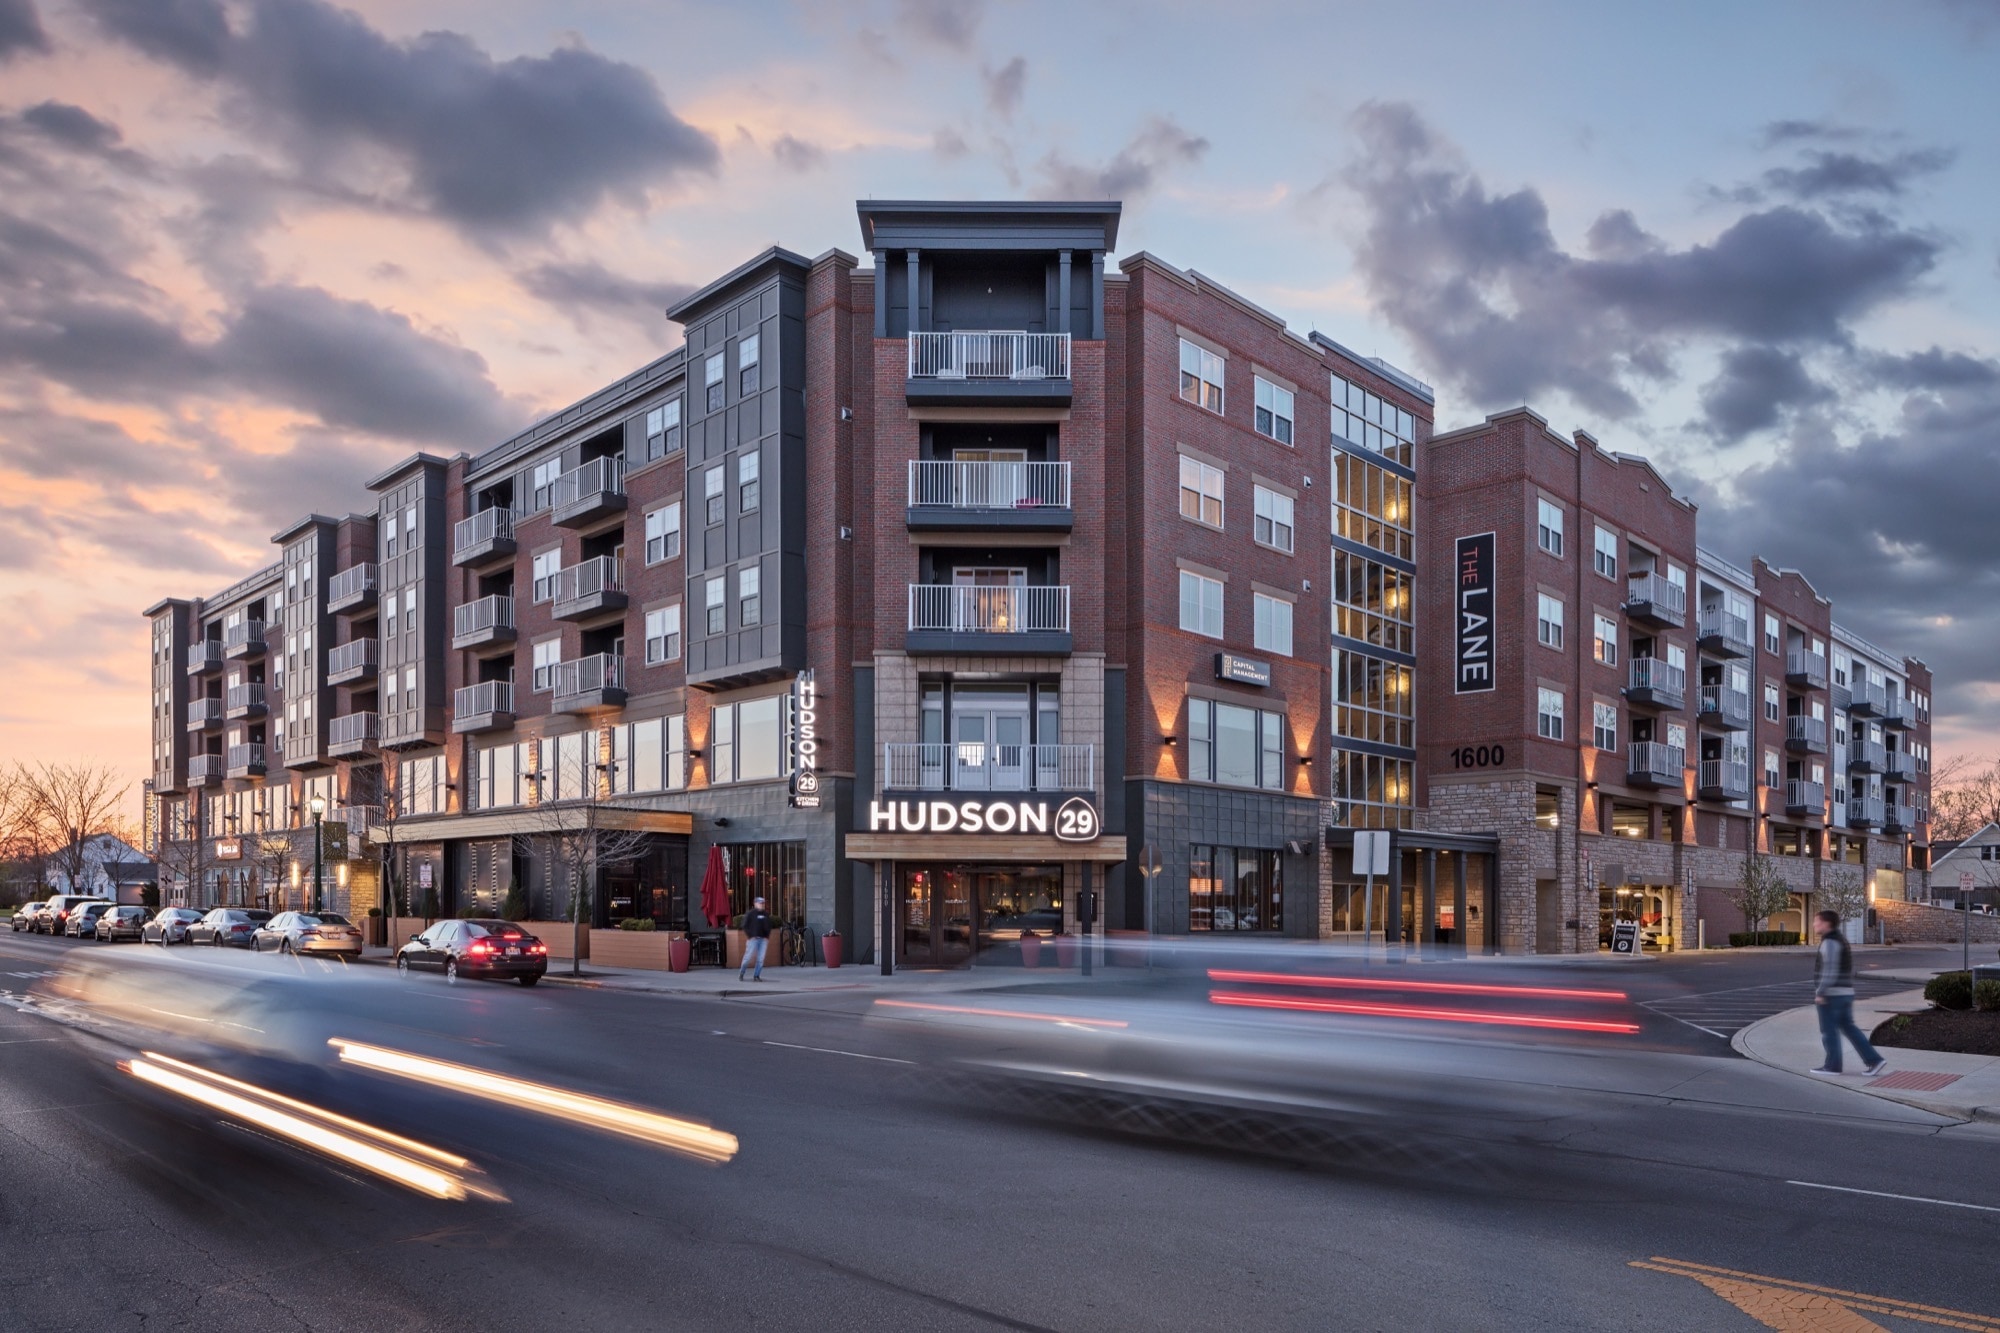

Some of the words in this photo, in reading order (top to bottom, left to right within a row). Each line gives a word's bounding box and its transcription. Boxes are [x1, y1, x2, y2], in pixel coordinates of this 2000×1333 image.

[1463, 546, 1478, 585] THE
[1463, 588, 1488, 682] LANE
[1233, 660, 1255, 671] CAPITAL
[1233, 669, 1268, 681] MANAGEMENT
[799, 681, 816, 769] HUDSON
[1451, 744, 1505, 769] 1600
[800, 777, 815, 790] 29
[870, 801, 1047, 832] HUDSON
[1061, 810, 1093, 834] 29
